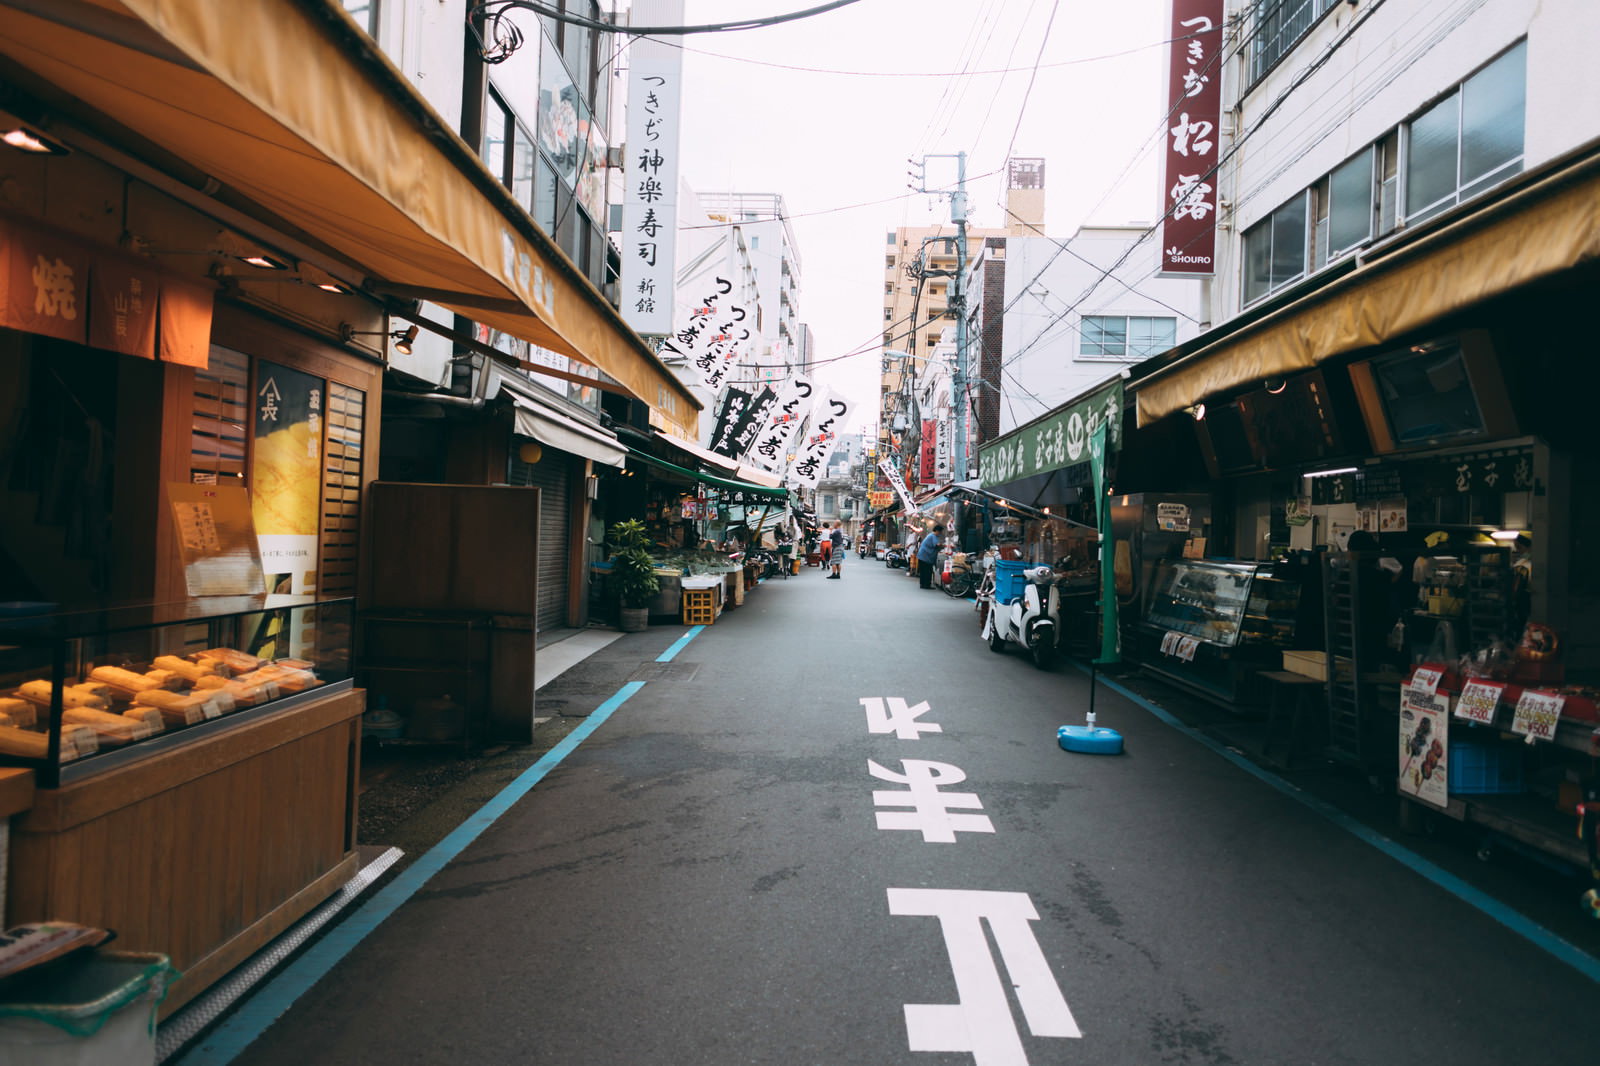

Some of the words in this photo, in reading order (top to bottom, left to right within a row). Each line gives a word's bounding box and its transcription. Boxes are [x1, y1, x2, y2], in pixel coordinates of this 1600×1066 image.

[635, 75, 666, 268] つきぢ神楽寿司
[31, 253, 77, 321] 焼
[634, 278, 656, 314] 新館
[1171, 255, 1211, 265] SHOURO
[796, 398, 848, 480] つくだ煮
[859, 696, 1082, 1066] 止まれ
